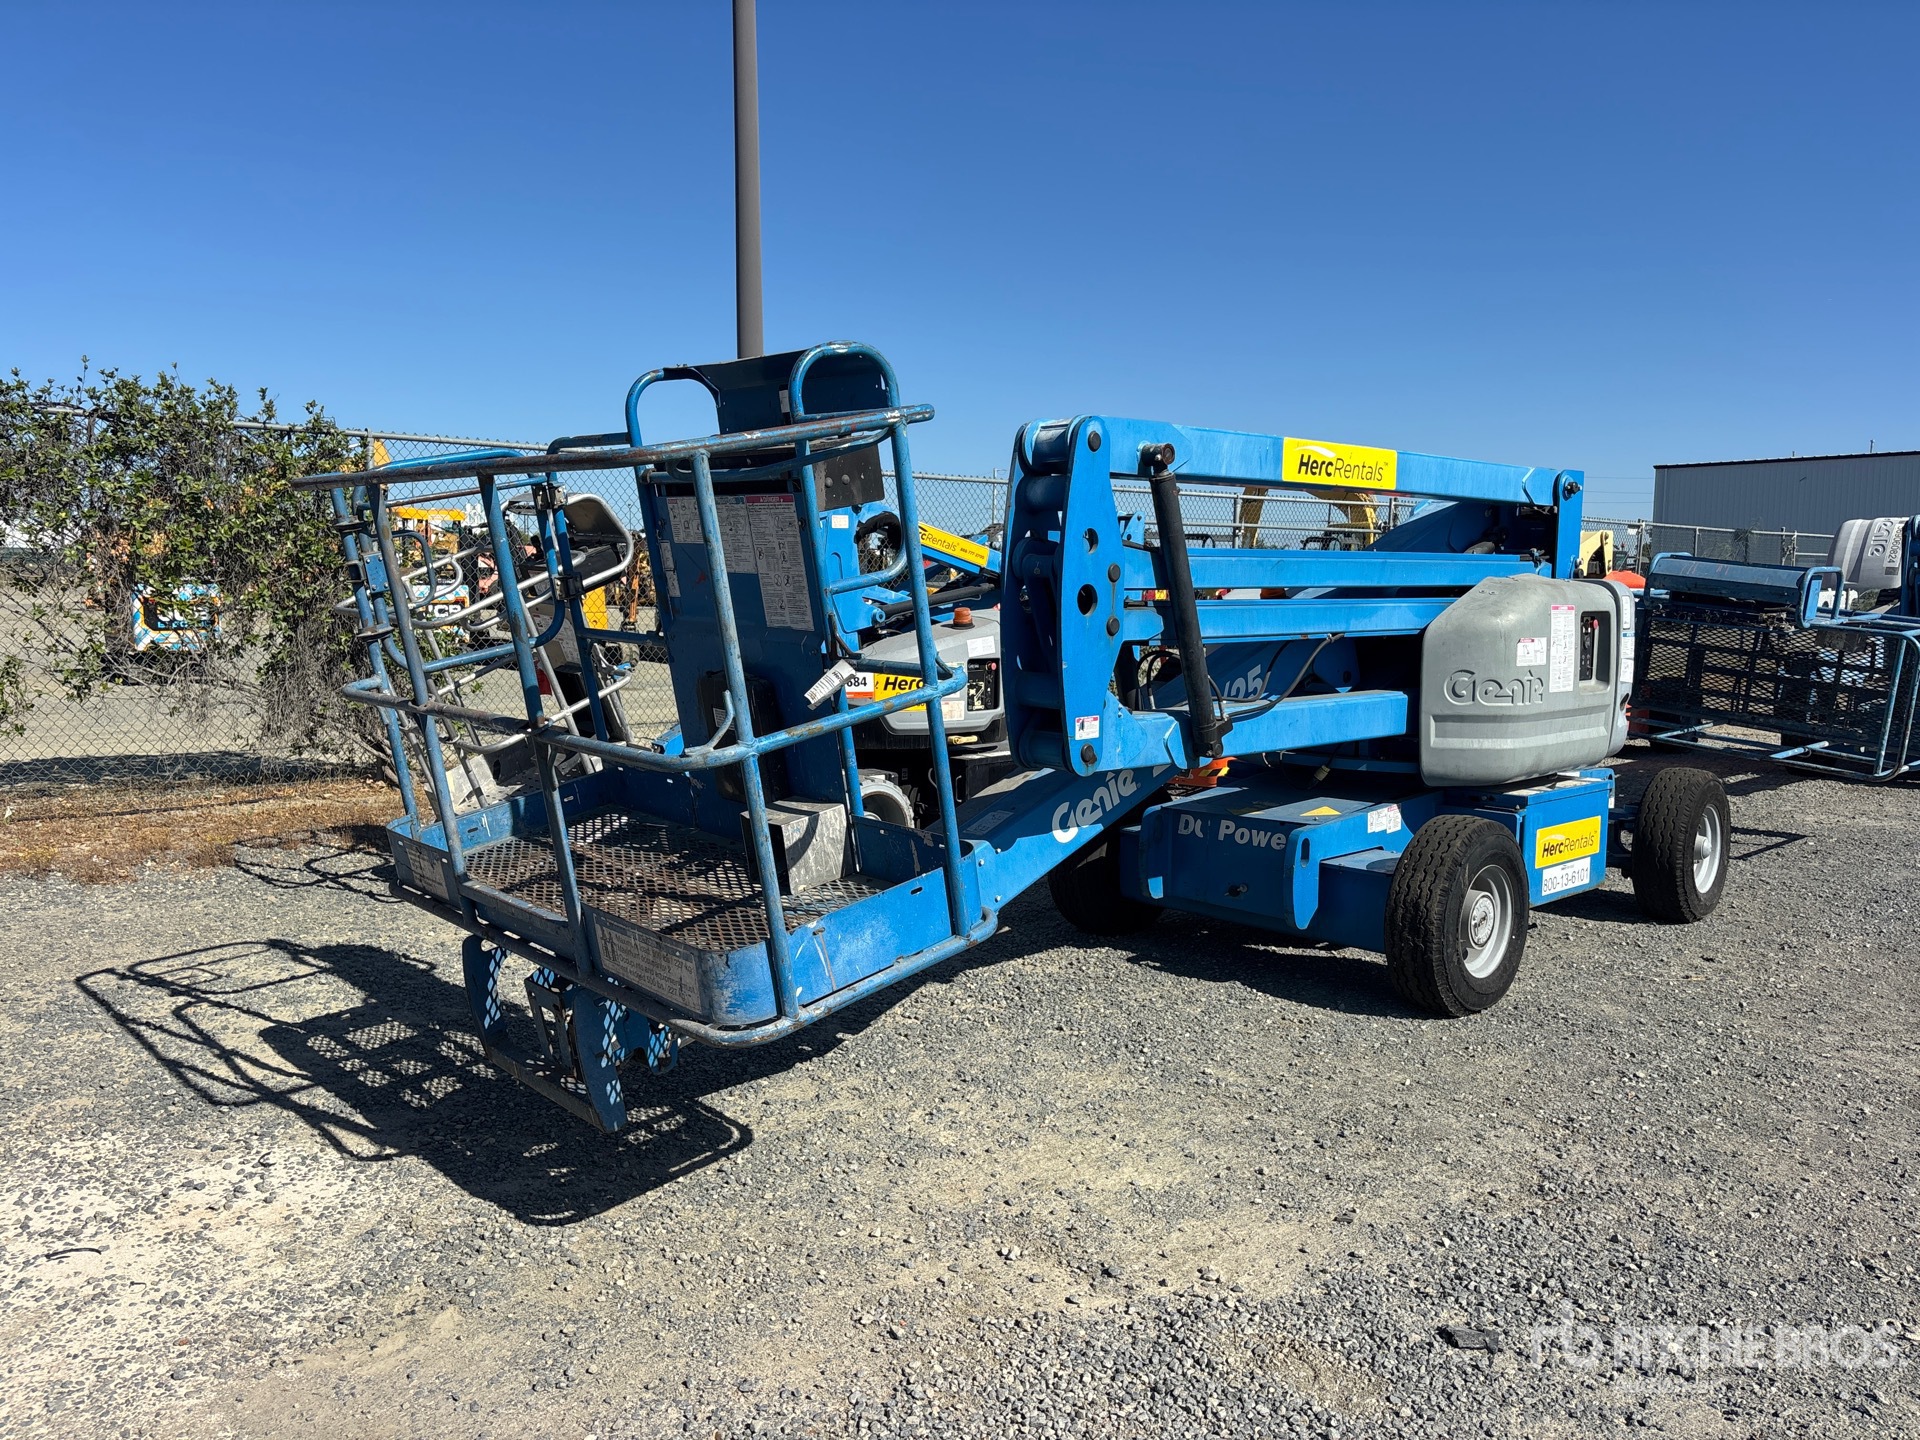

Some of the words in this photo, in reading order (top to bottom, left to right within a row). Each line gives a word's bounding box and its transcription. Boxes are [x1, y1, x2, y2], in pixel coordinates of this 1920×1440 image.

[1443, 669, 1546, 707] Genie
[1051, 769, 1138, 844] Genie
[1217, 819, 1287, 851] Powe
[1542, 867, 1589, 893] 800-13-6101
